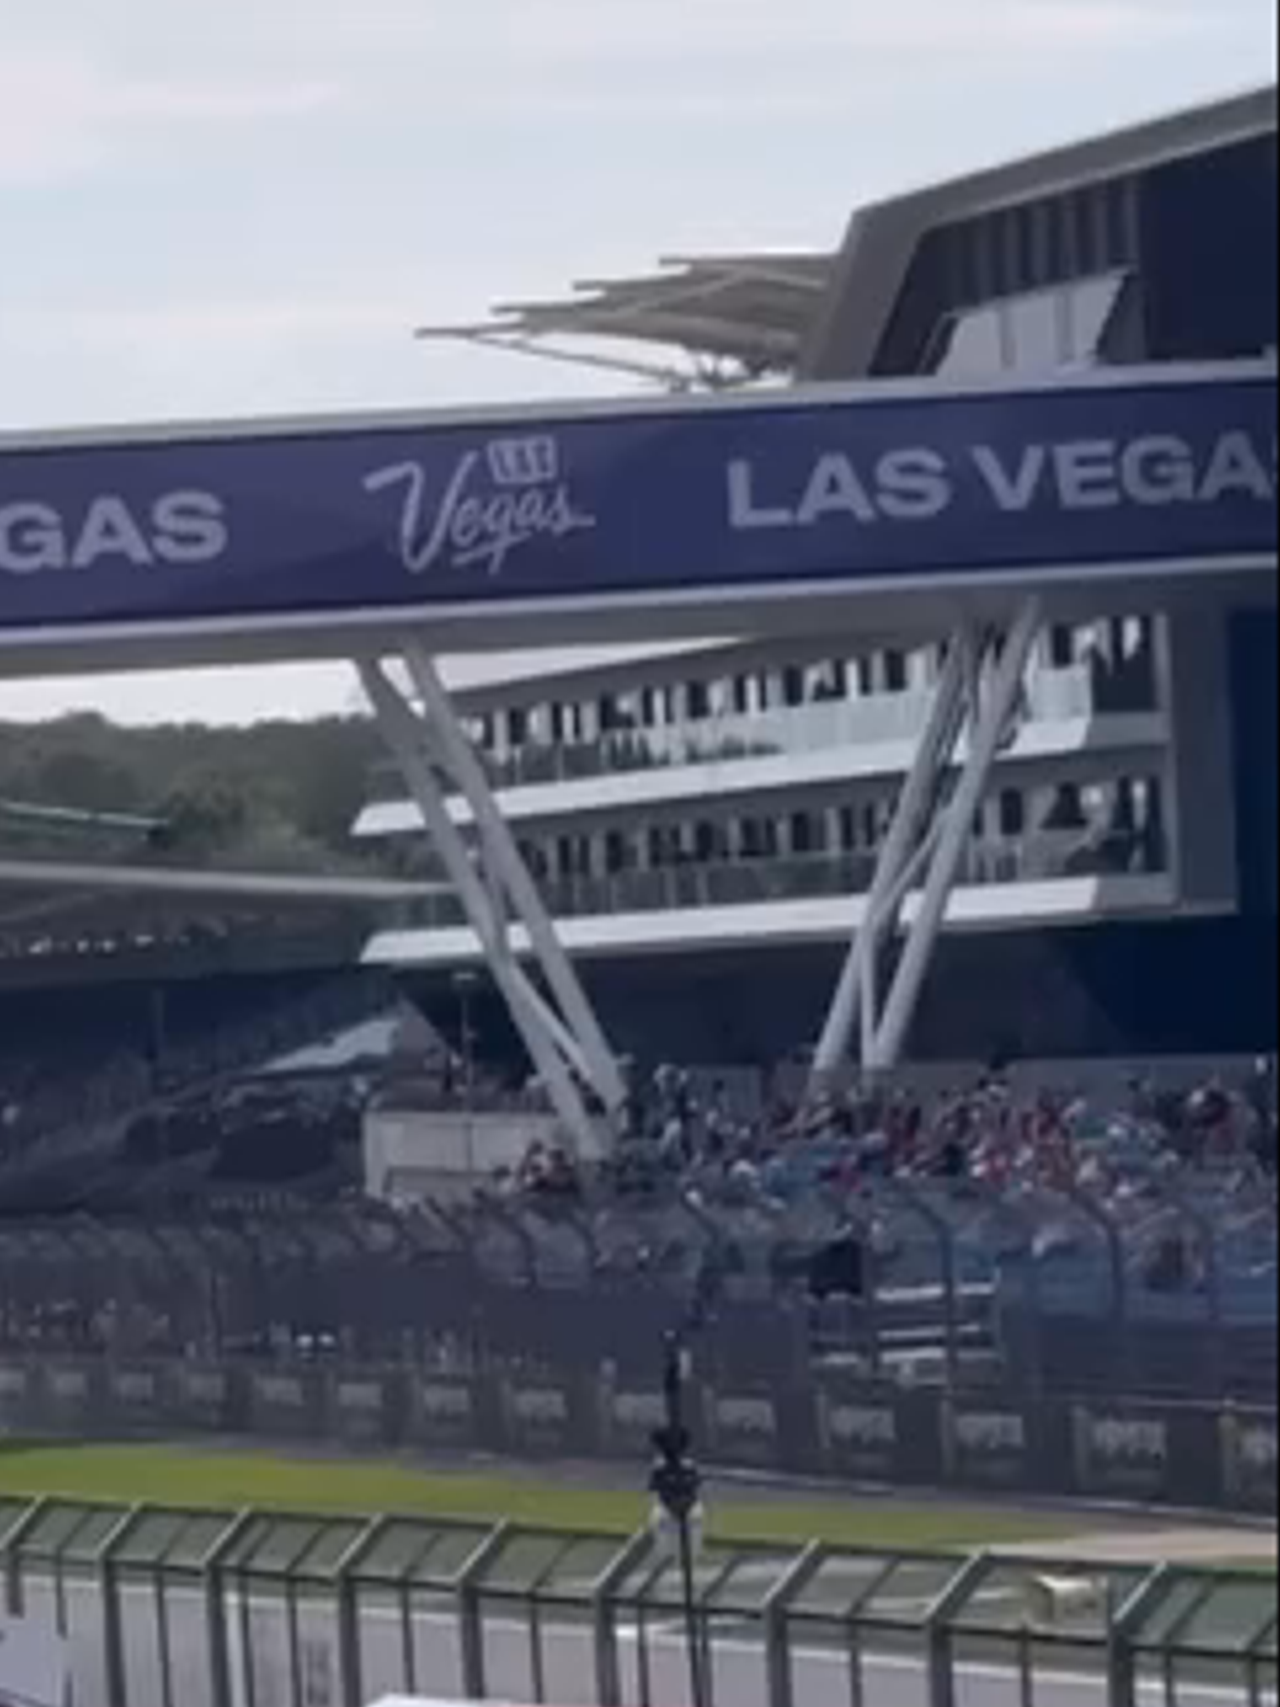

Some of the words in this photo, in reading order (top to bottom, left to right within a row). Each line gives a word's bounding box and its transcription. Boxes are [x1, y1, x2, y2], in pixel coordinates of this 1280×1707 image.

[362, 449, 596, 575] Vegas
[728, 448, 951, 528] LAS
[972, 429, 1278, 510] VEGA
